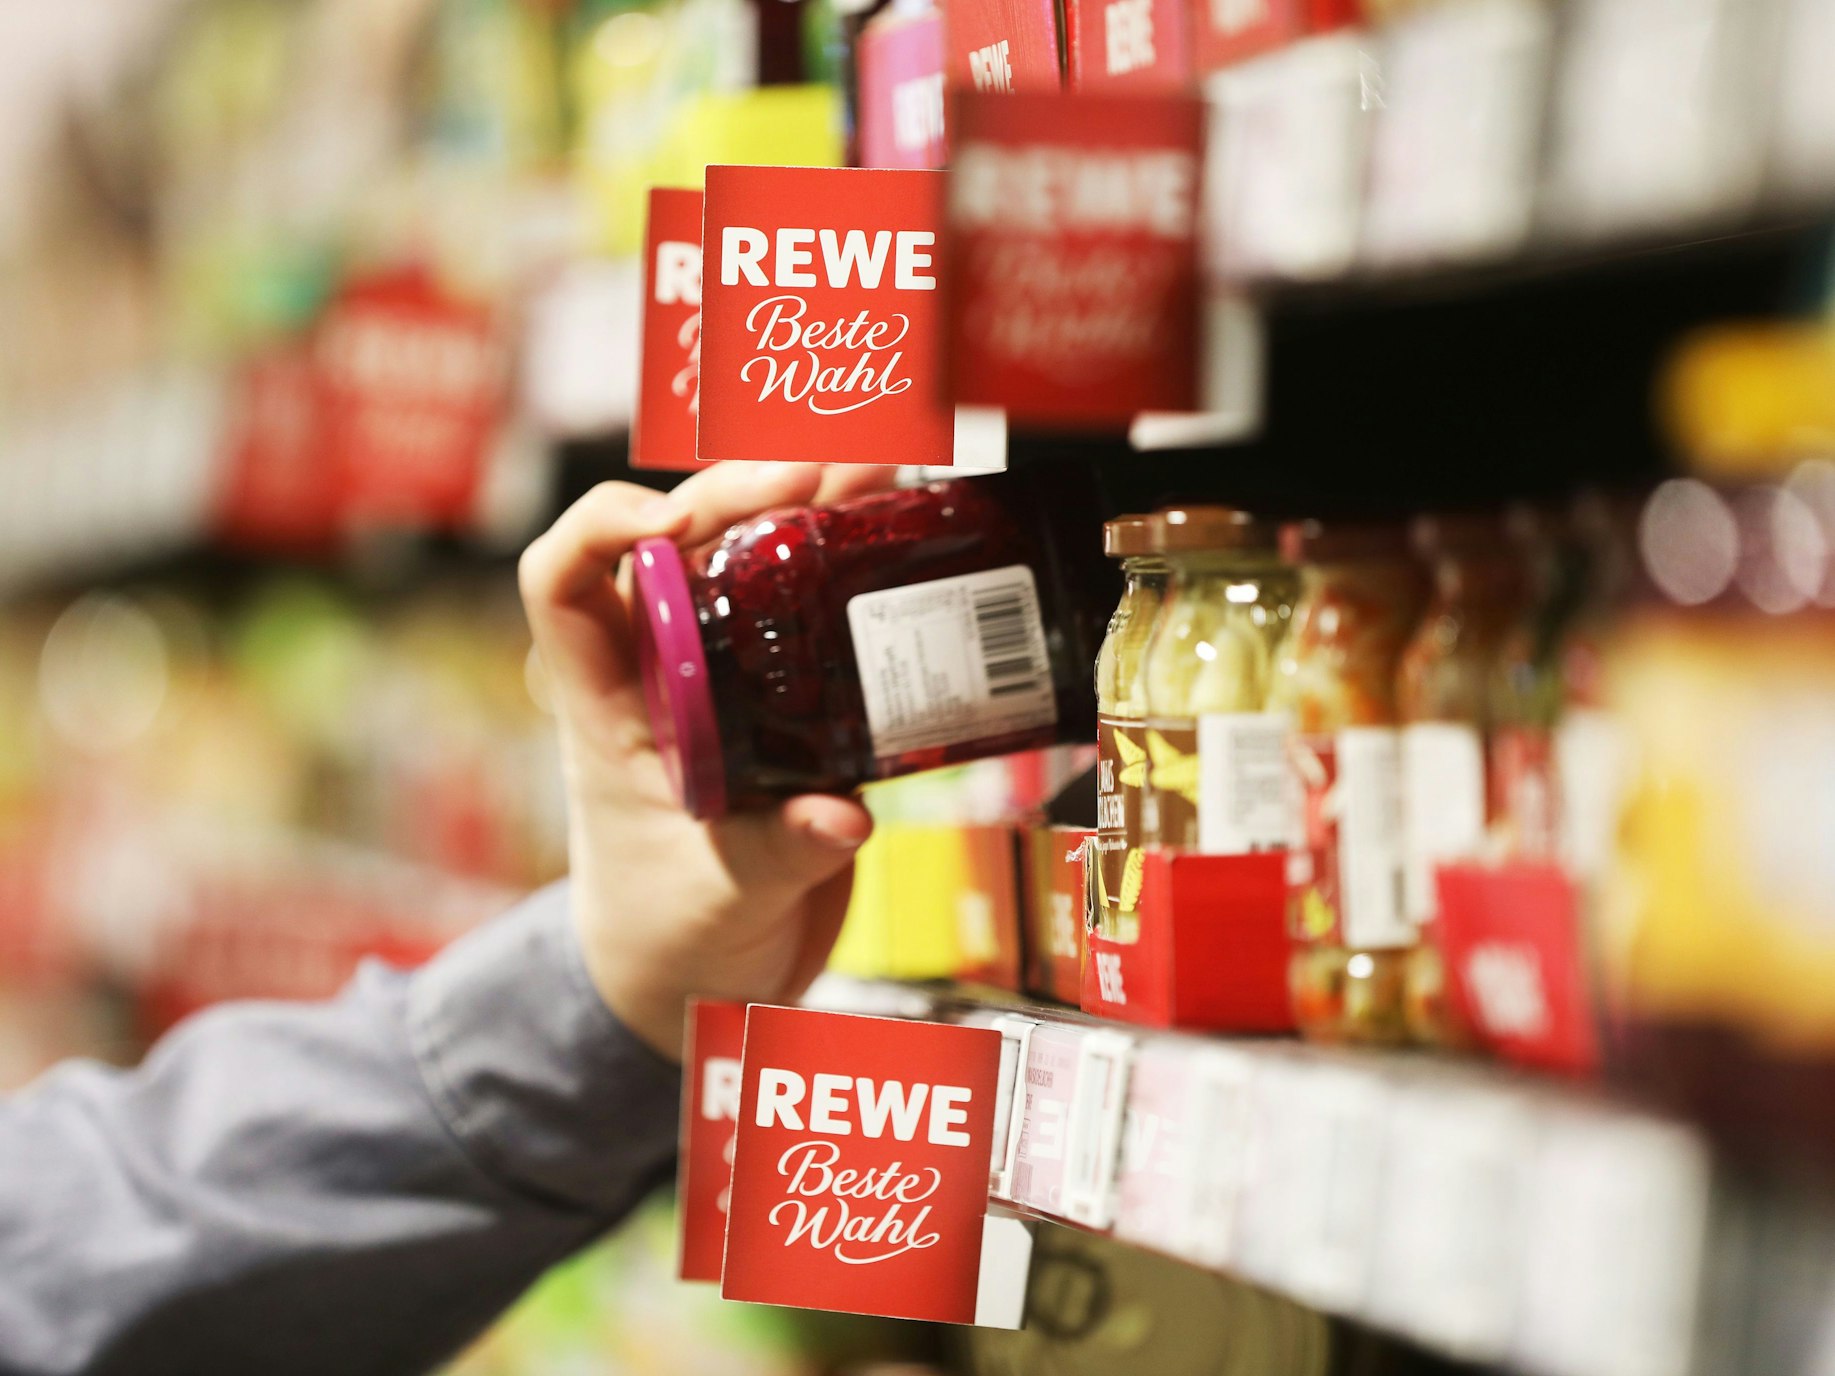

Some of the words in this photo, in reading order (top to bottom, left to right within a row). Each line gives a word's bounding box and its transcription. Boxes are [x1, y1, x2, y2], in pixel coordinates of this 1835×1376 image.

[720, 226, 937, 291] REWE
[745, 294, 910, 351] Beste
[740, 350, 913, 415] Wahl
[755, 1067, 973, 1147] REWE
[777, 1140, 942, 1203] Beste
[768, 1198, 941, 1265] Wahl
